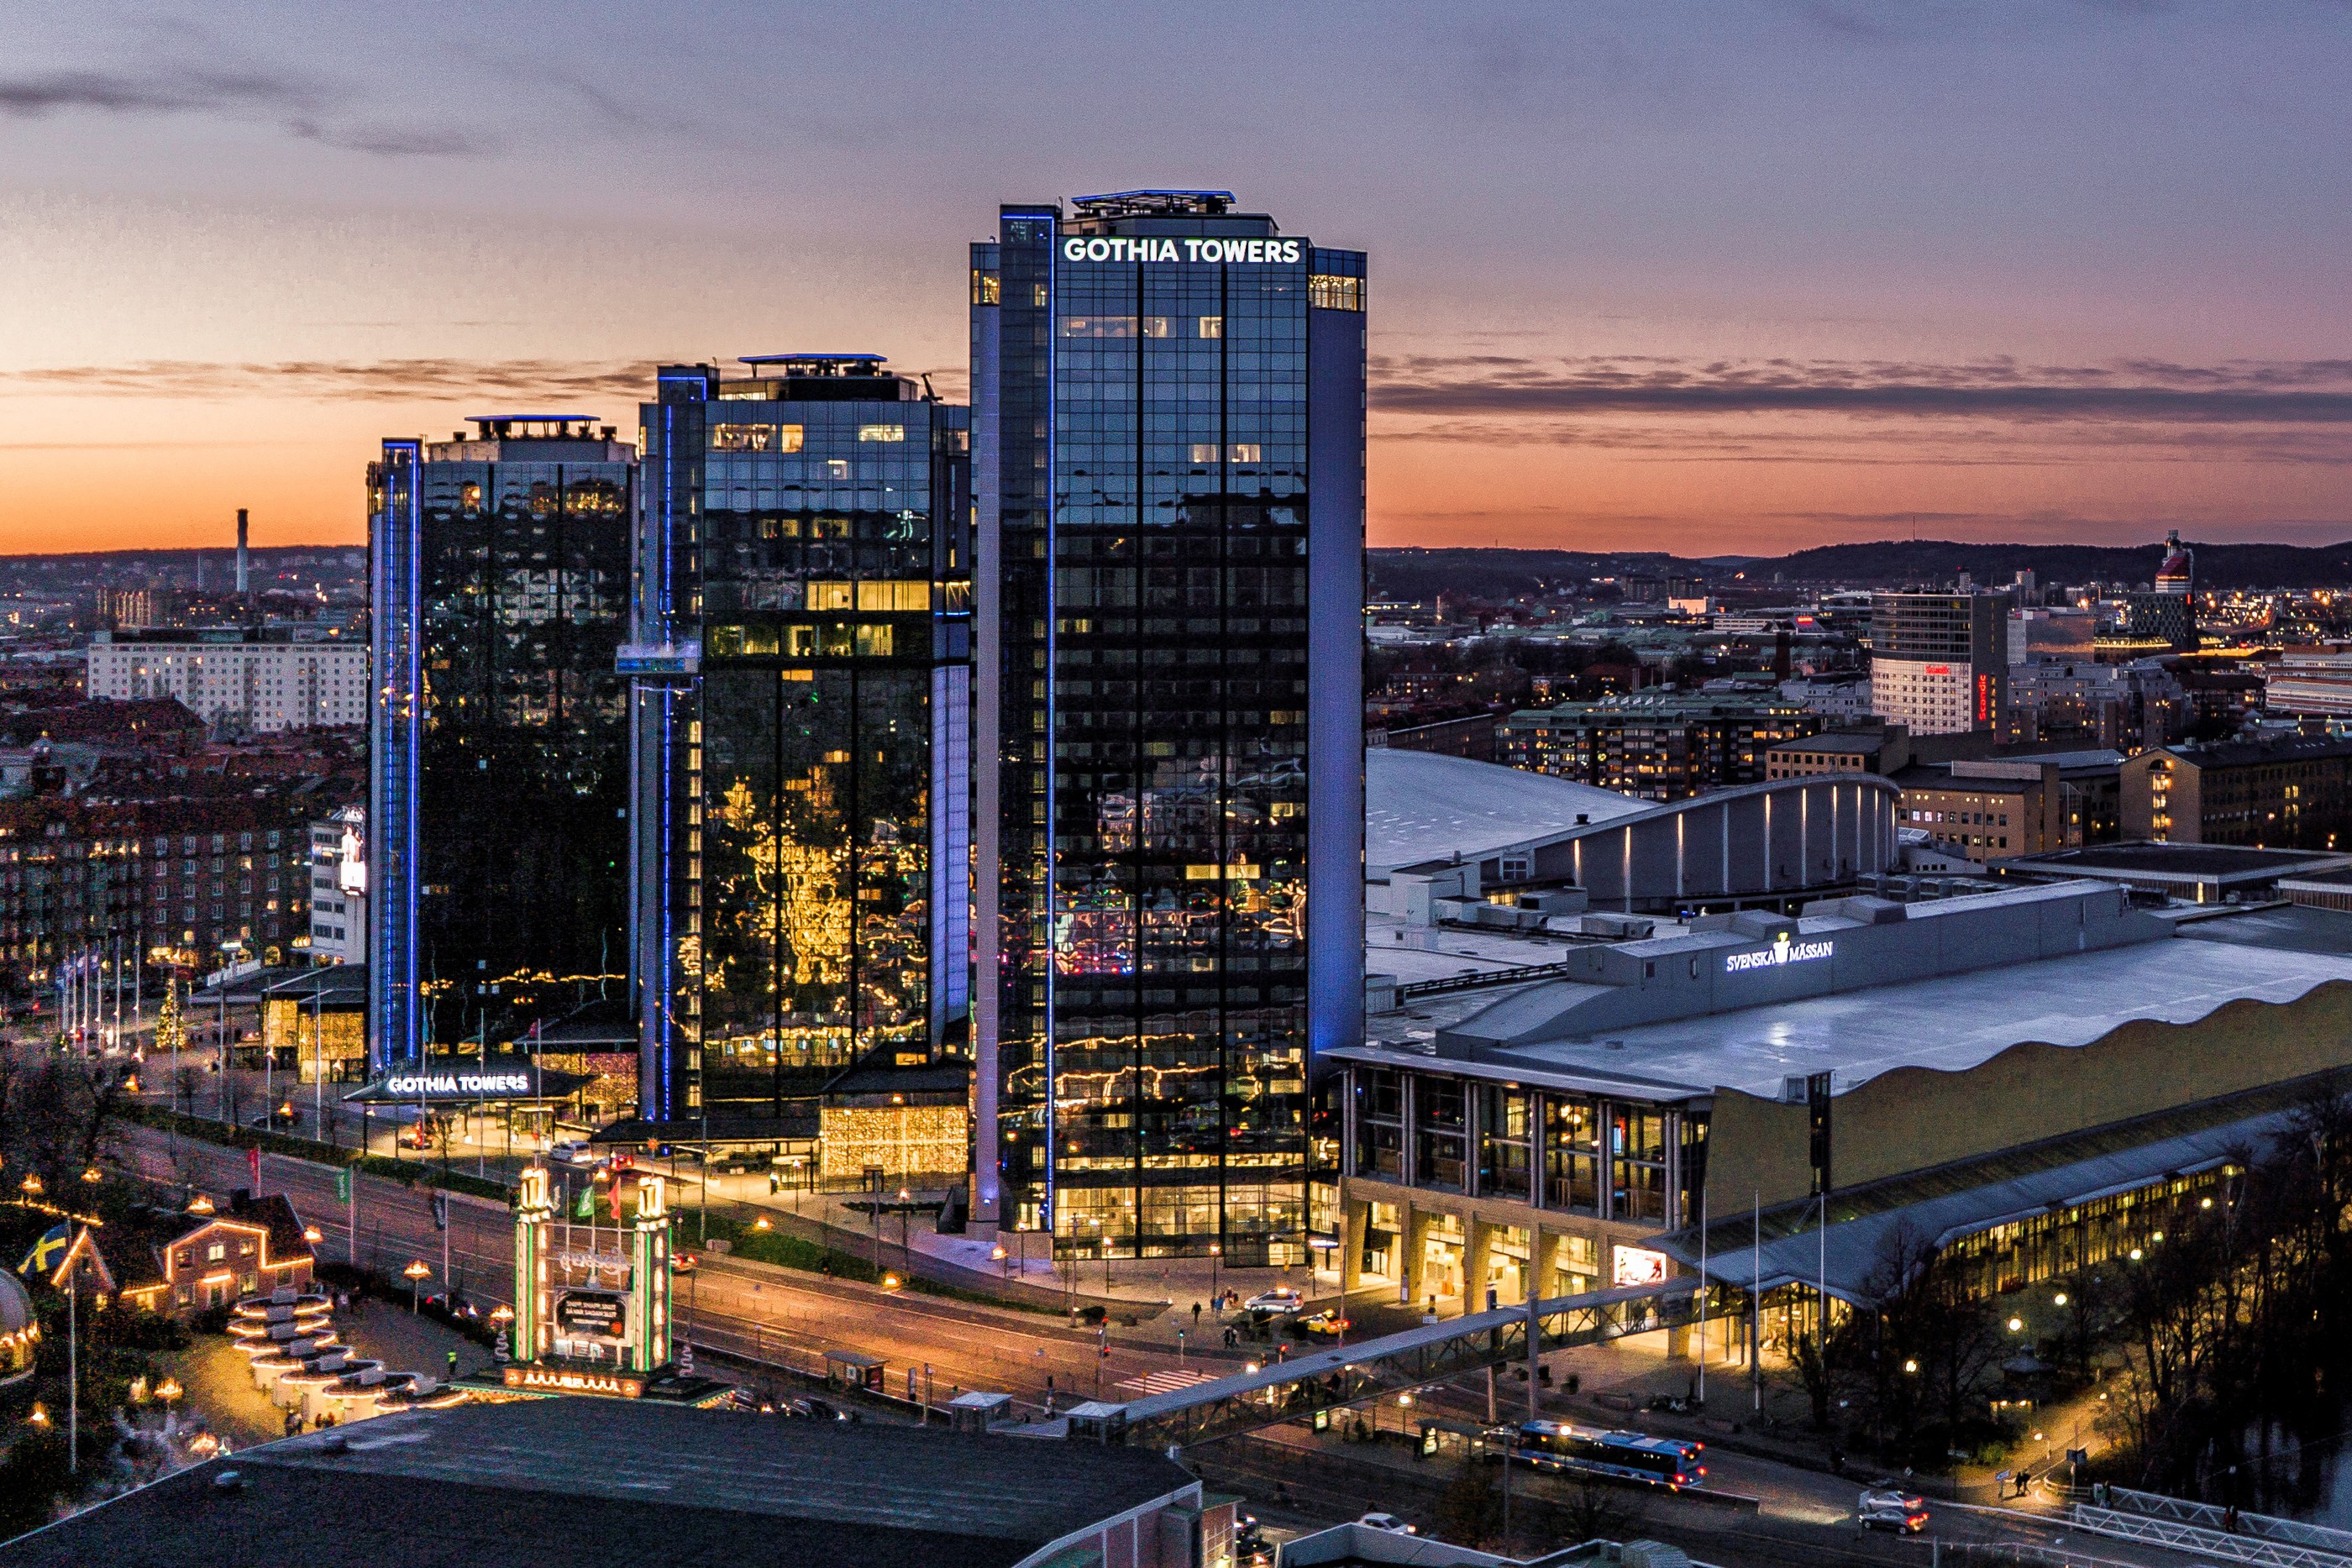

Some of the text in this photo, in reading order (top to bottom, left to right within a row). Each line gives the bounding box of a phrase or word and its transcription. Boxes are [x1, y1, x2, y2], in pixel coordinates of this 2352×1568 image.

[1064, 238, 1300, 263] GOTHIA TOWERS
[1978, 674, 1987, 721] Scandic
[1726, 941, 1833, 972] SVENSKA MÄSSAN
[388, 1075, 529, 1093] GOTHIA TOWERS
